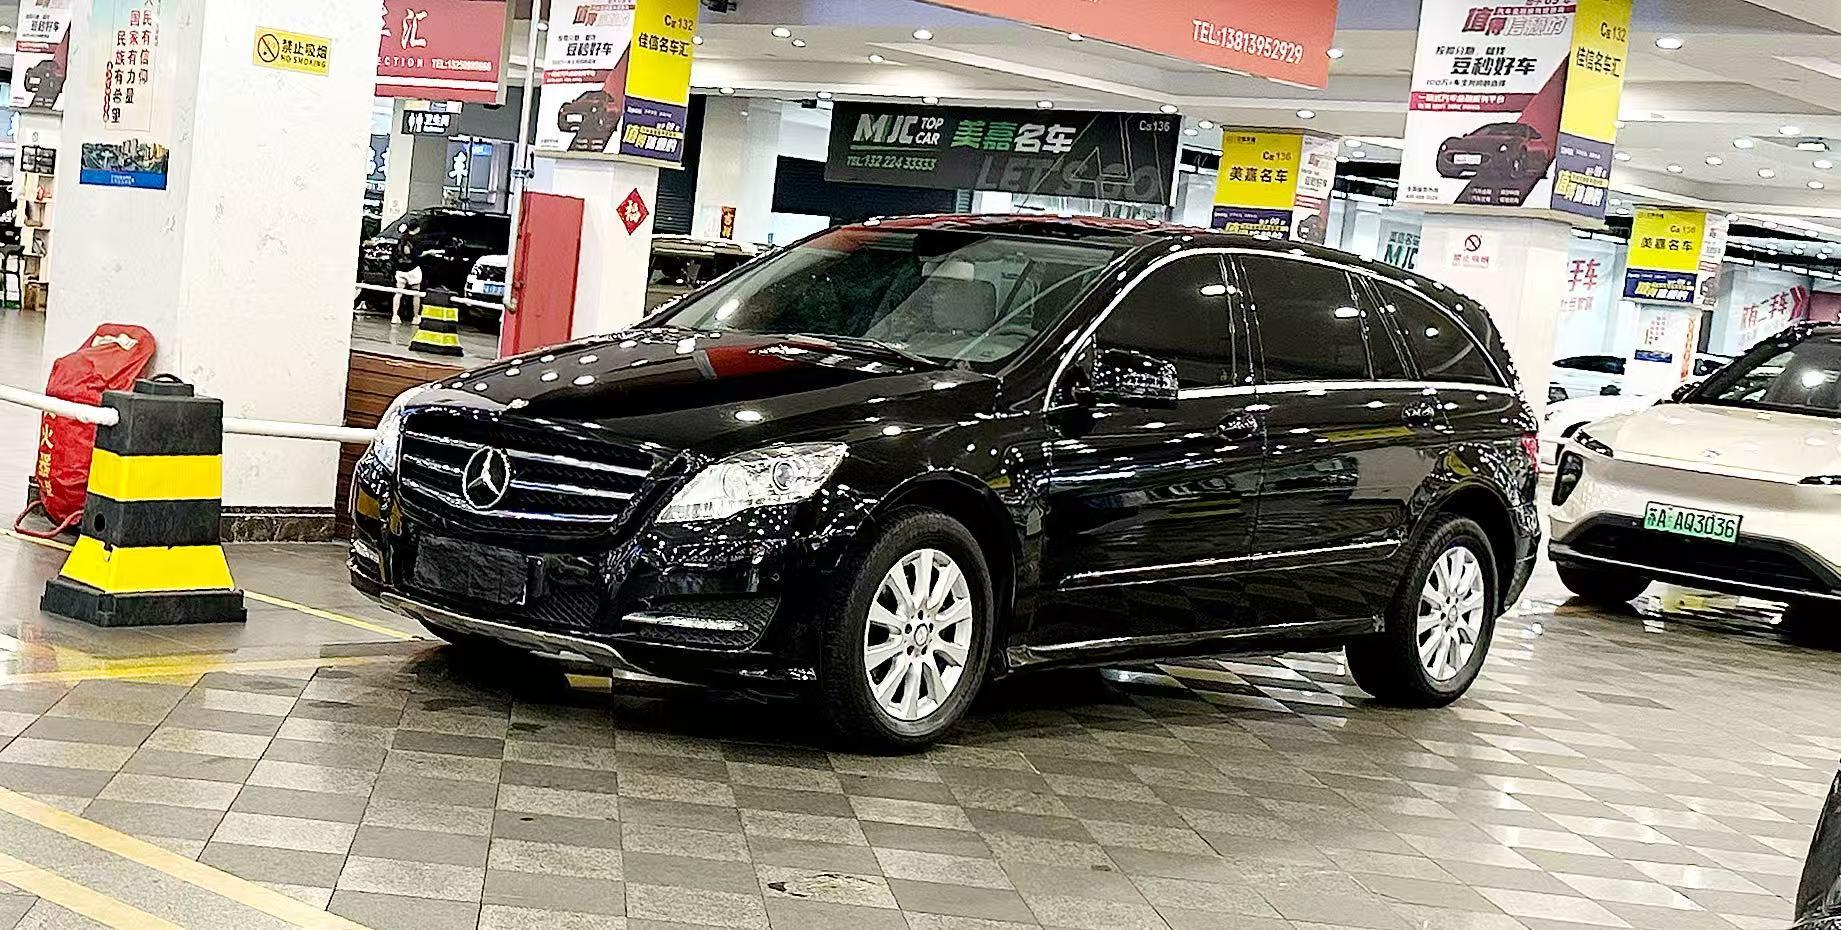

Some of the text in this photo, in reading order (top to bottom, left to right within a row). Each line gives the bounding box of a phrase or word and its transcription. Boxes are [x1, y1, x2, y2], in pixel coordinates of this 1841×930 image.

[281, 39, 328, 60] 禁止吸烟
[1191, 19, 1304, 65] TEL:13813952929
[852, 113, 944, 145] MJC TOP
[915, 132, 941, 145] CAR
[950, 119, 1078, 154] 美嘉名车
[1673, 511, 1736, 538] AQ3036
